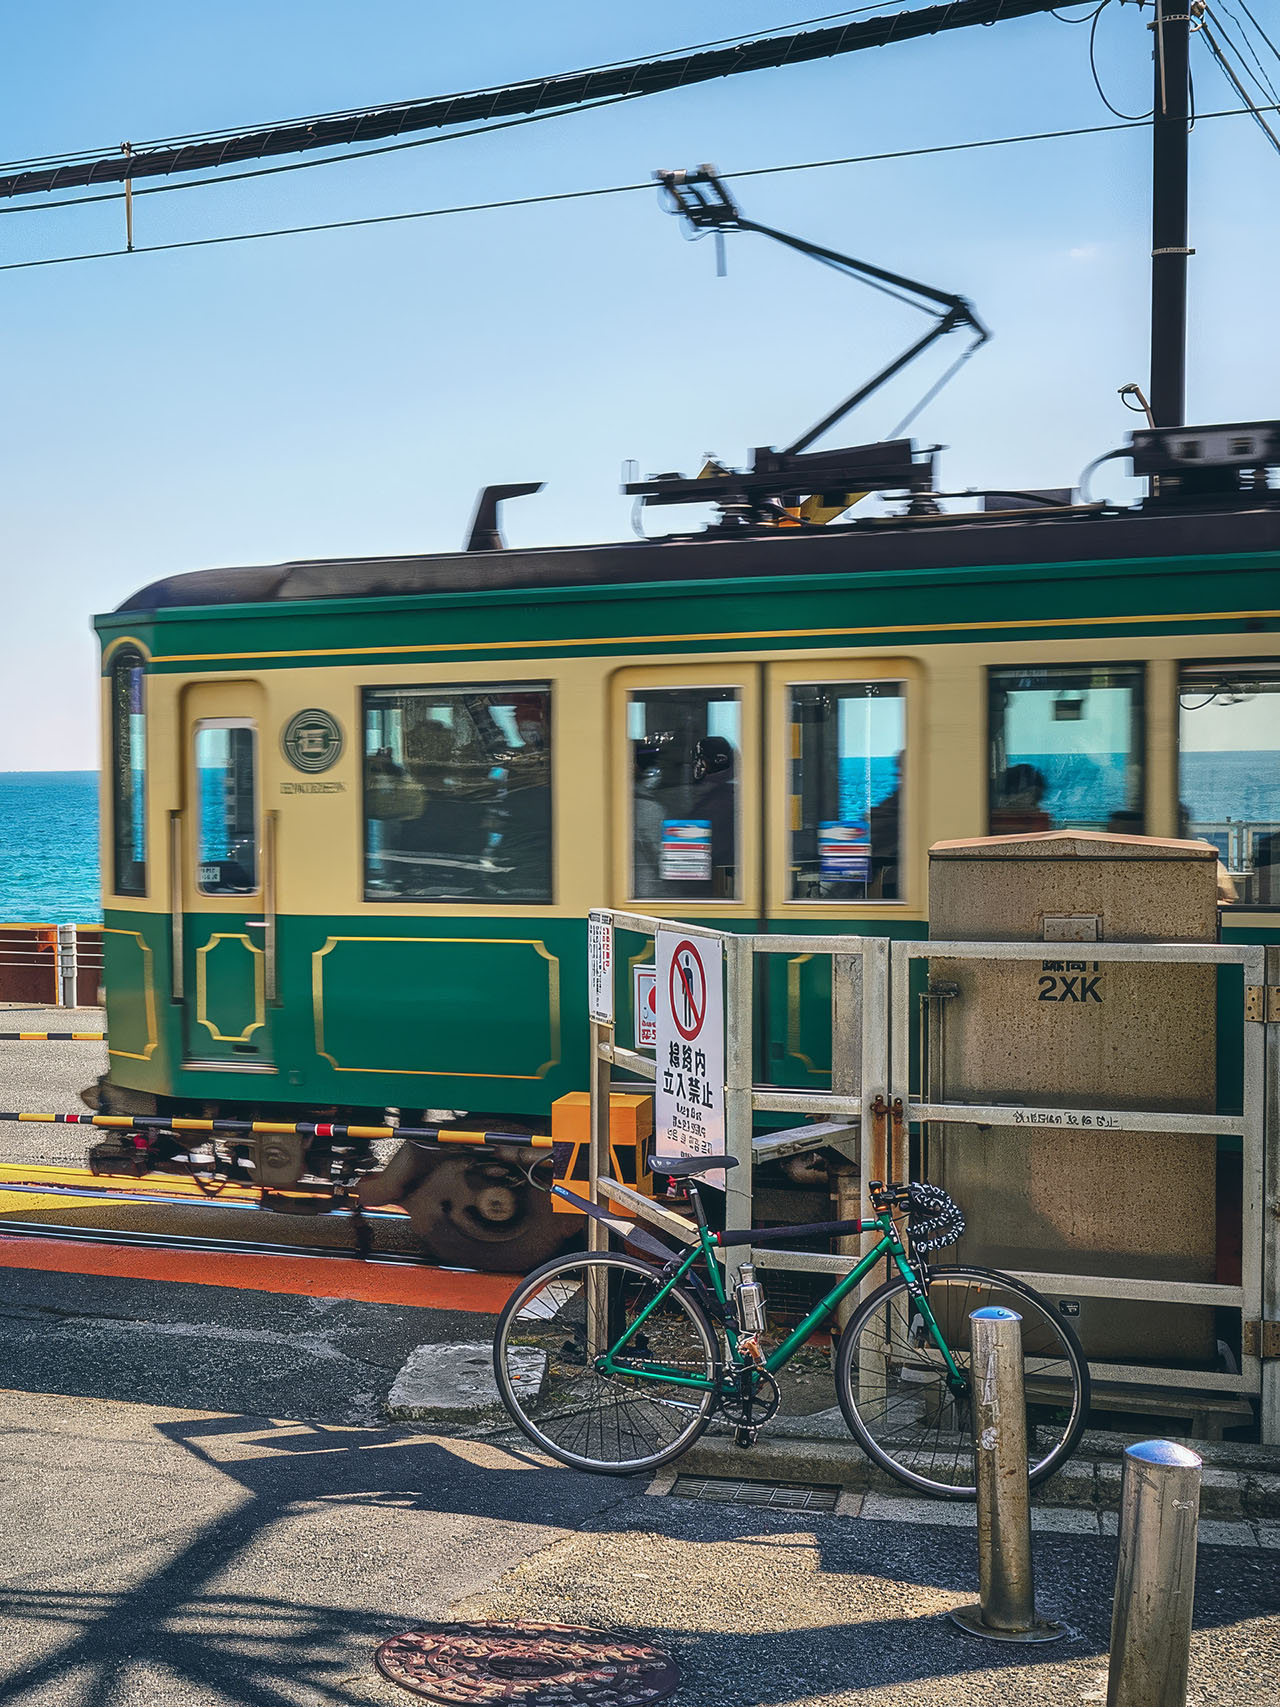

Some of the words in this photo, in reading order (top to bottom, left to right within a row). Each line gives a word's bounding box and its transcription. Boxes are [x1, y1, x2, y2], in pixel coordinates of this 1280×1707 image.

[1038, 975, 1103, 1002] 2XK
[663, 1068, 713, 1109] 立入禁止
